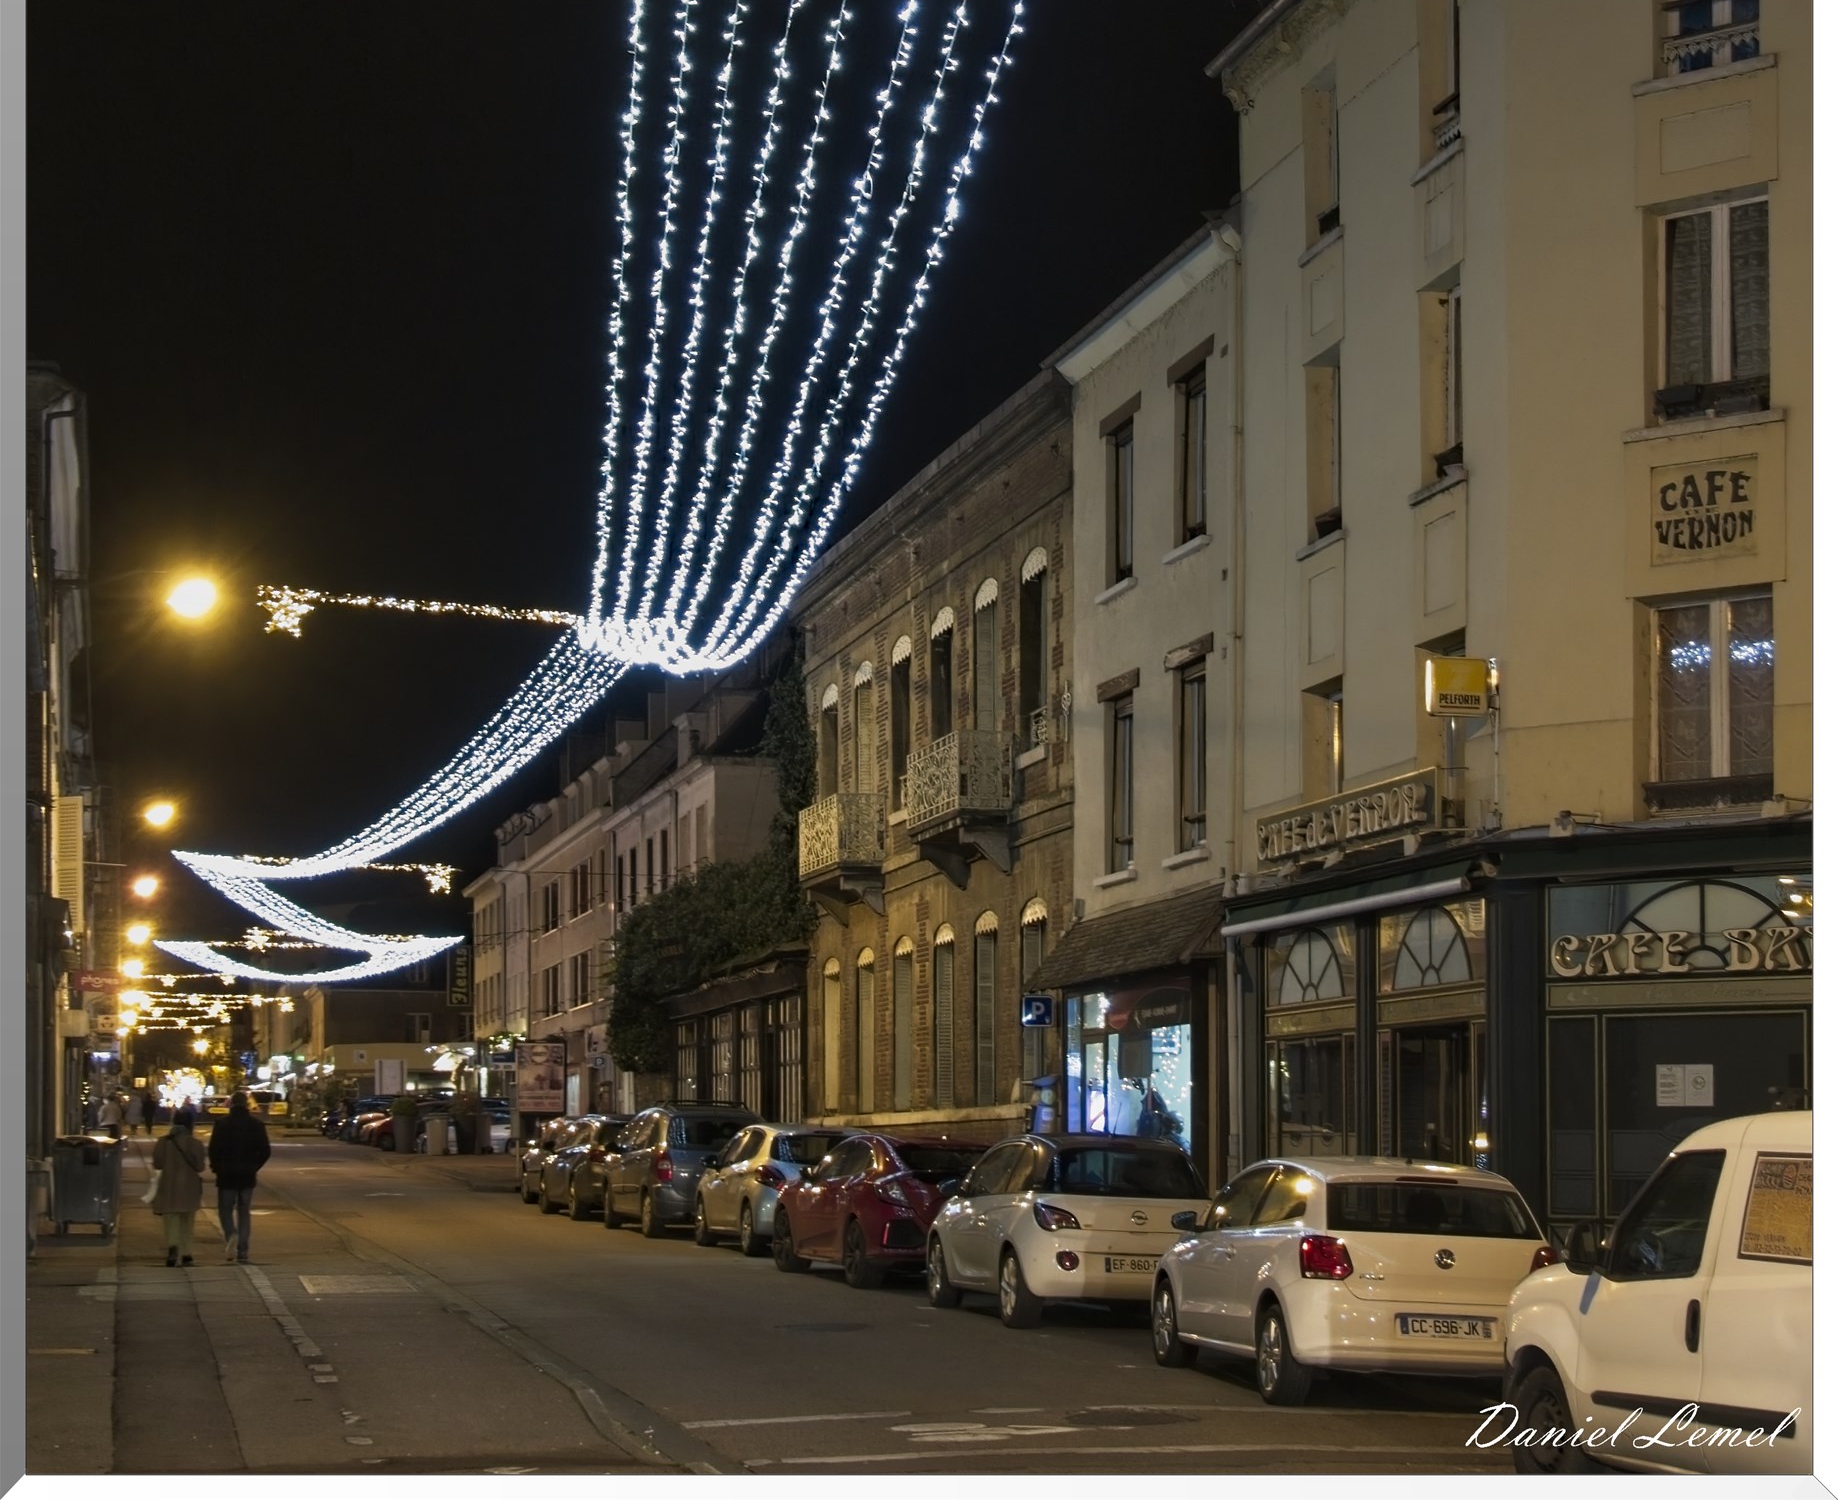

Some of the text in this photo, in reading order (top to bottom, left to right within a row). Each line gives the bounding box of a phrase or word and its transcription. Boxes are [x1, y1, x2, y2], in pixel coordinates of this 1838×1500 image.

[1655, 509, 1754, 550] VERNON
[1439, 693, 1481, 706] PELFORTH
[1306, 812, 1336, 849] de
[1330, 783, 1427, 842] VERNON
[1551, 926, 1813, 978] CAFE BA
[1031, 1001, 1045, 1020] P
[1411, 1319, 1480, 1336] CC-696-JK
